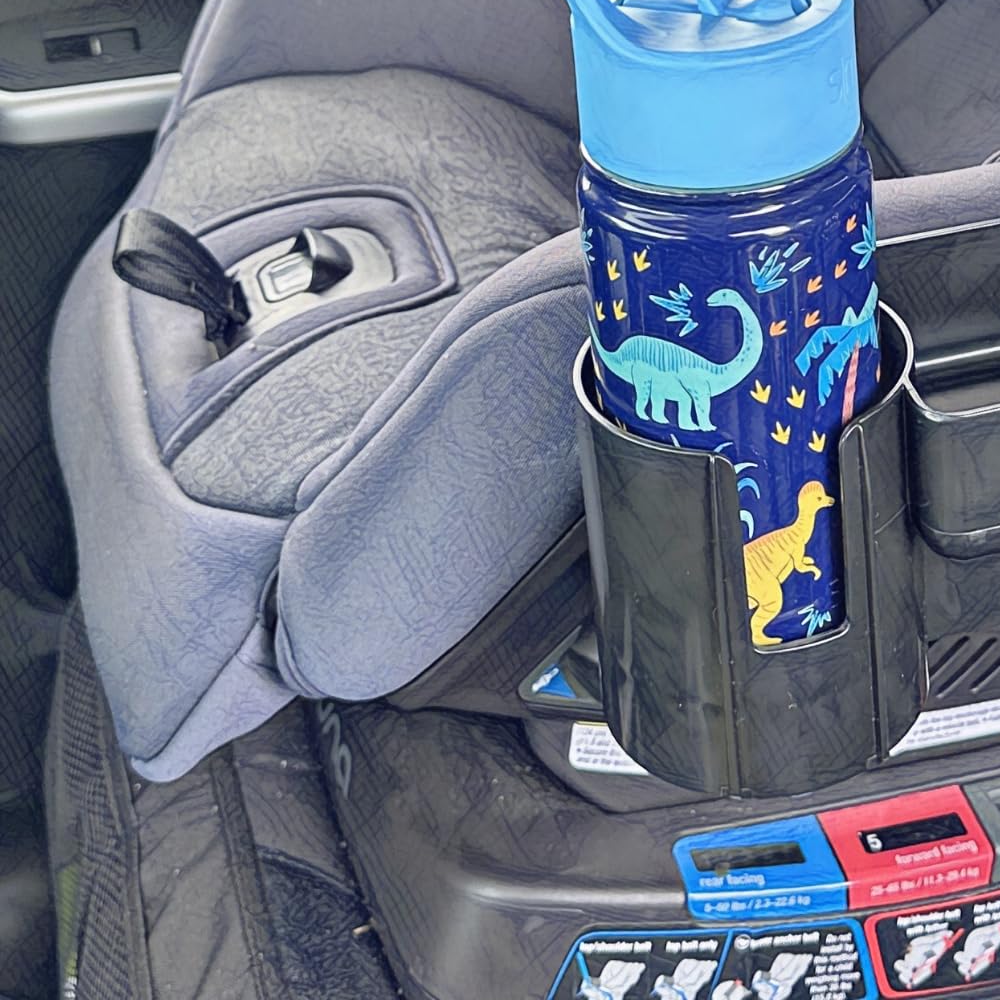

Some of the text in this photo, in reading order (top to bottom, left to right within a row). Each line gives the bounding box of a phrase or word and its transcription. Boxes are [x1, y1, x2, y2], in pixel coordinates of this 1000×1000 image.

[866, 833, 883, 852] 5
[895, 839, 979, 865] forward facing
[699, 873, 766, 889] rear facing
